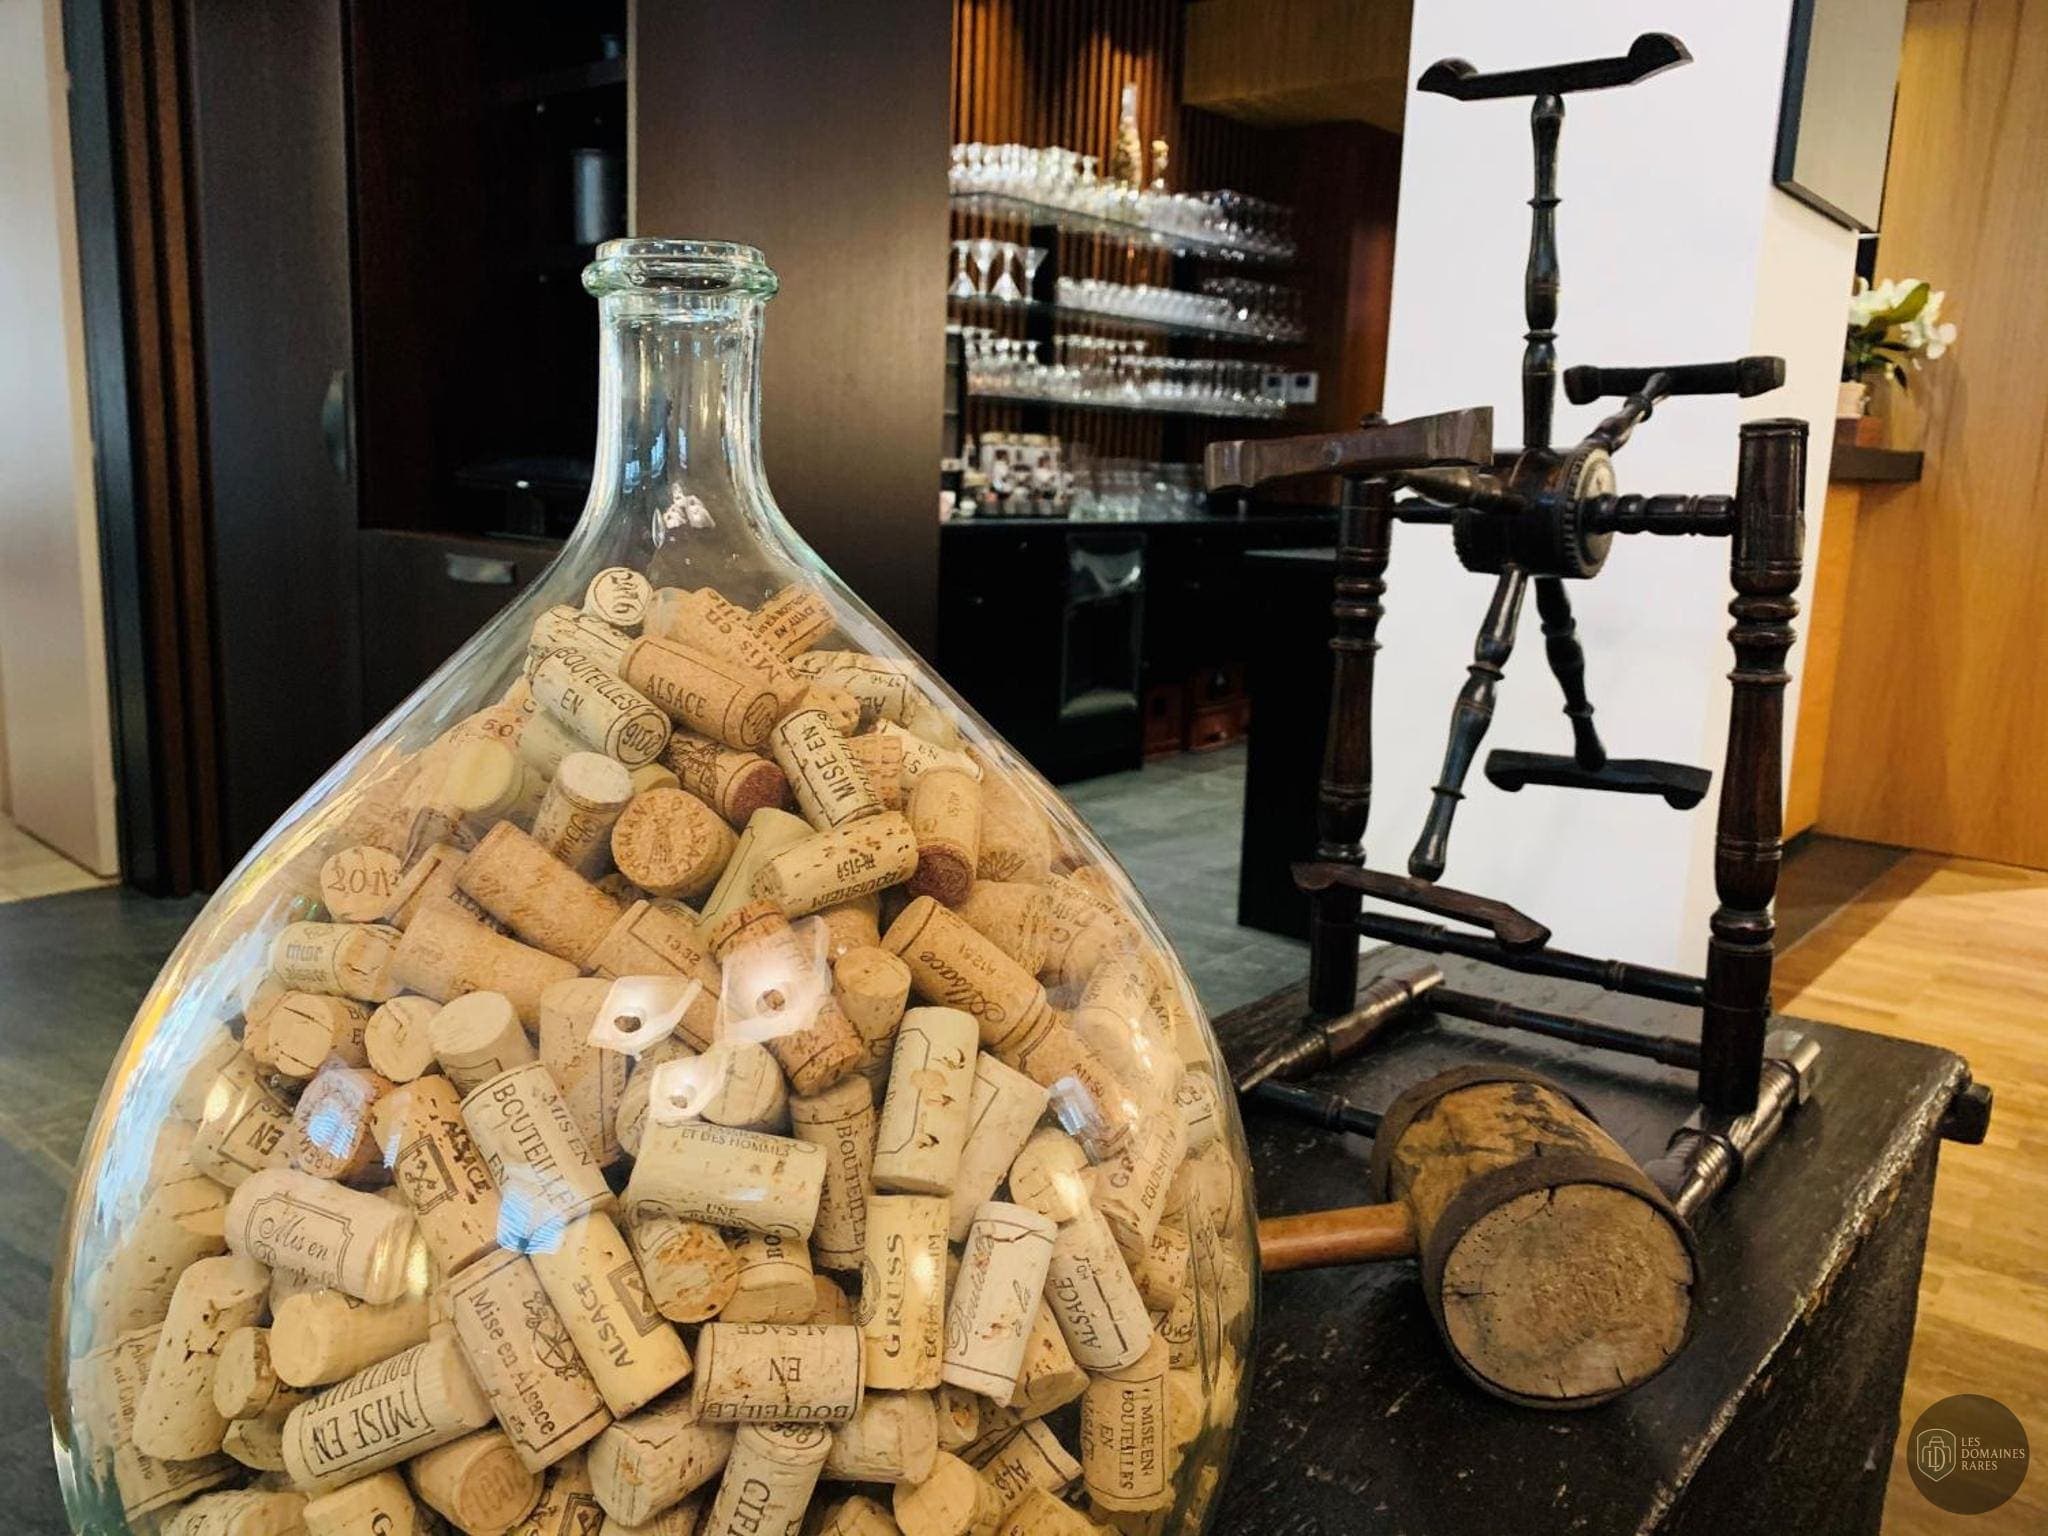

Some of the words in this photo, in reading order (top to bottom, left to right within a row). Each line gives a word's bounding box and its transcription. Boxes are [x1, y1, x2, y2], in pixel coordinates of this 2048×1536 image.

[560, 687, 585, 717] EN
[644, 673, 707, 719] ALSACE
[801, 724, 826, 752] EN
[815, 753, 857, 802] MISE
[920, 951, 1006, 1022] Alsace
[567, 1133, 592, 1167] EN
[835, 1123, 867, 1247] BOUTEILLE
[706, 1202, 739, 1218] UNE
[307, 1241, 330, 1262] en
[884, 1233, 904, 1358] GRUSS
[1051, 1276, 1102, 1351] ALSACE
[572, 1275, 635, 1369] ALSACE
[469, 1286, 505, 1342] Mise
[497, 1342, 518, 1368] en
[511, 1371, 556, 1436] Alsace
[768, 1356, 803, 1383] EN
[311, 1416, 348, 1465] EN
[352, 1390, 418, 1450] MISE
[1100, 1423, 1115, 1451] EN
[1140, 1404, 1156, 1443] MISE
